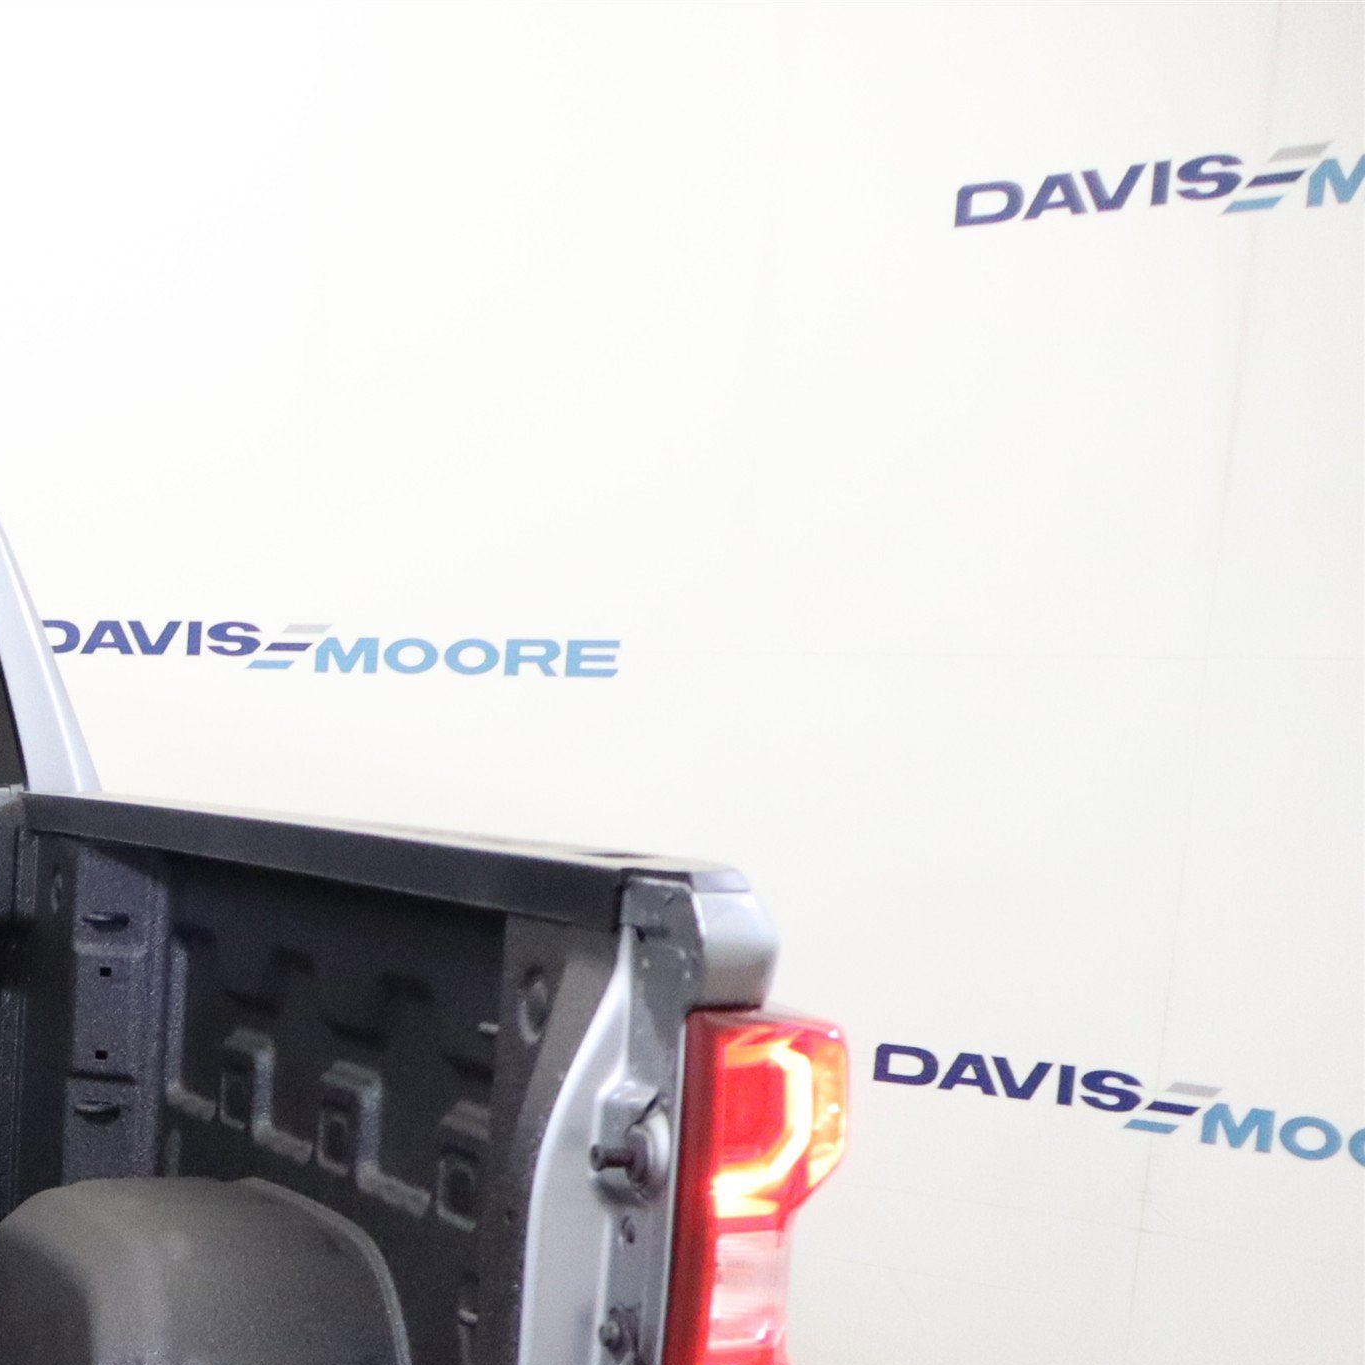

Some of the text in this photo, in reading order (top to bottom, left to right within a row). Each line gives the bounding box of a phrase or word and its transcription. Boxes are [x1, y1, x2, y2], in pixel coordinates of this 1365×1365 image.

[954, 153, 1243, 227] DAVIS
[314, 636, 621, 679] MOORE
[873, 1043, 1142, 1112] DAVIS
